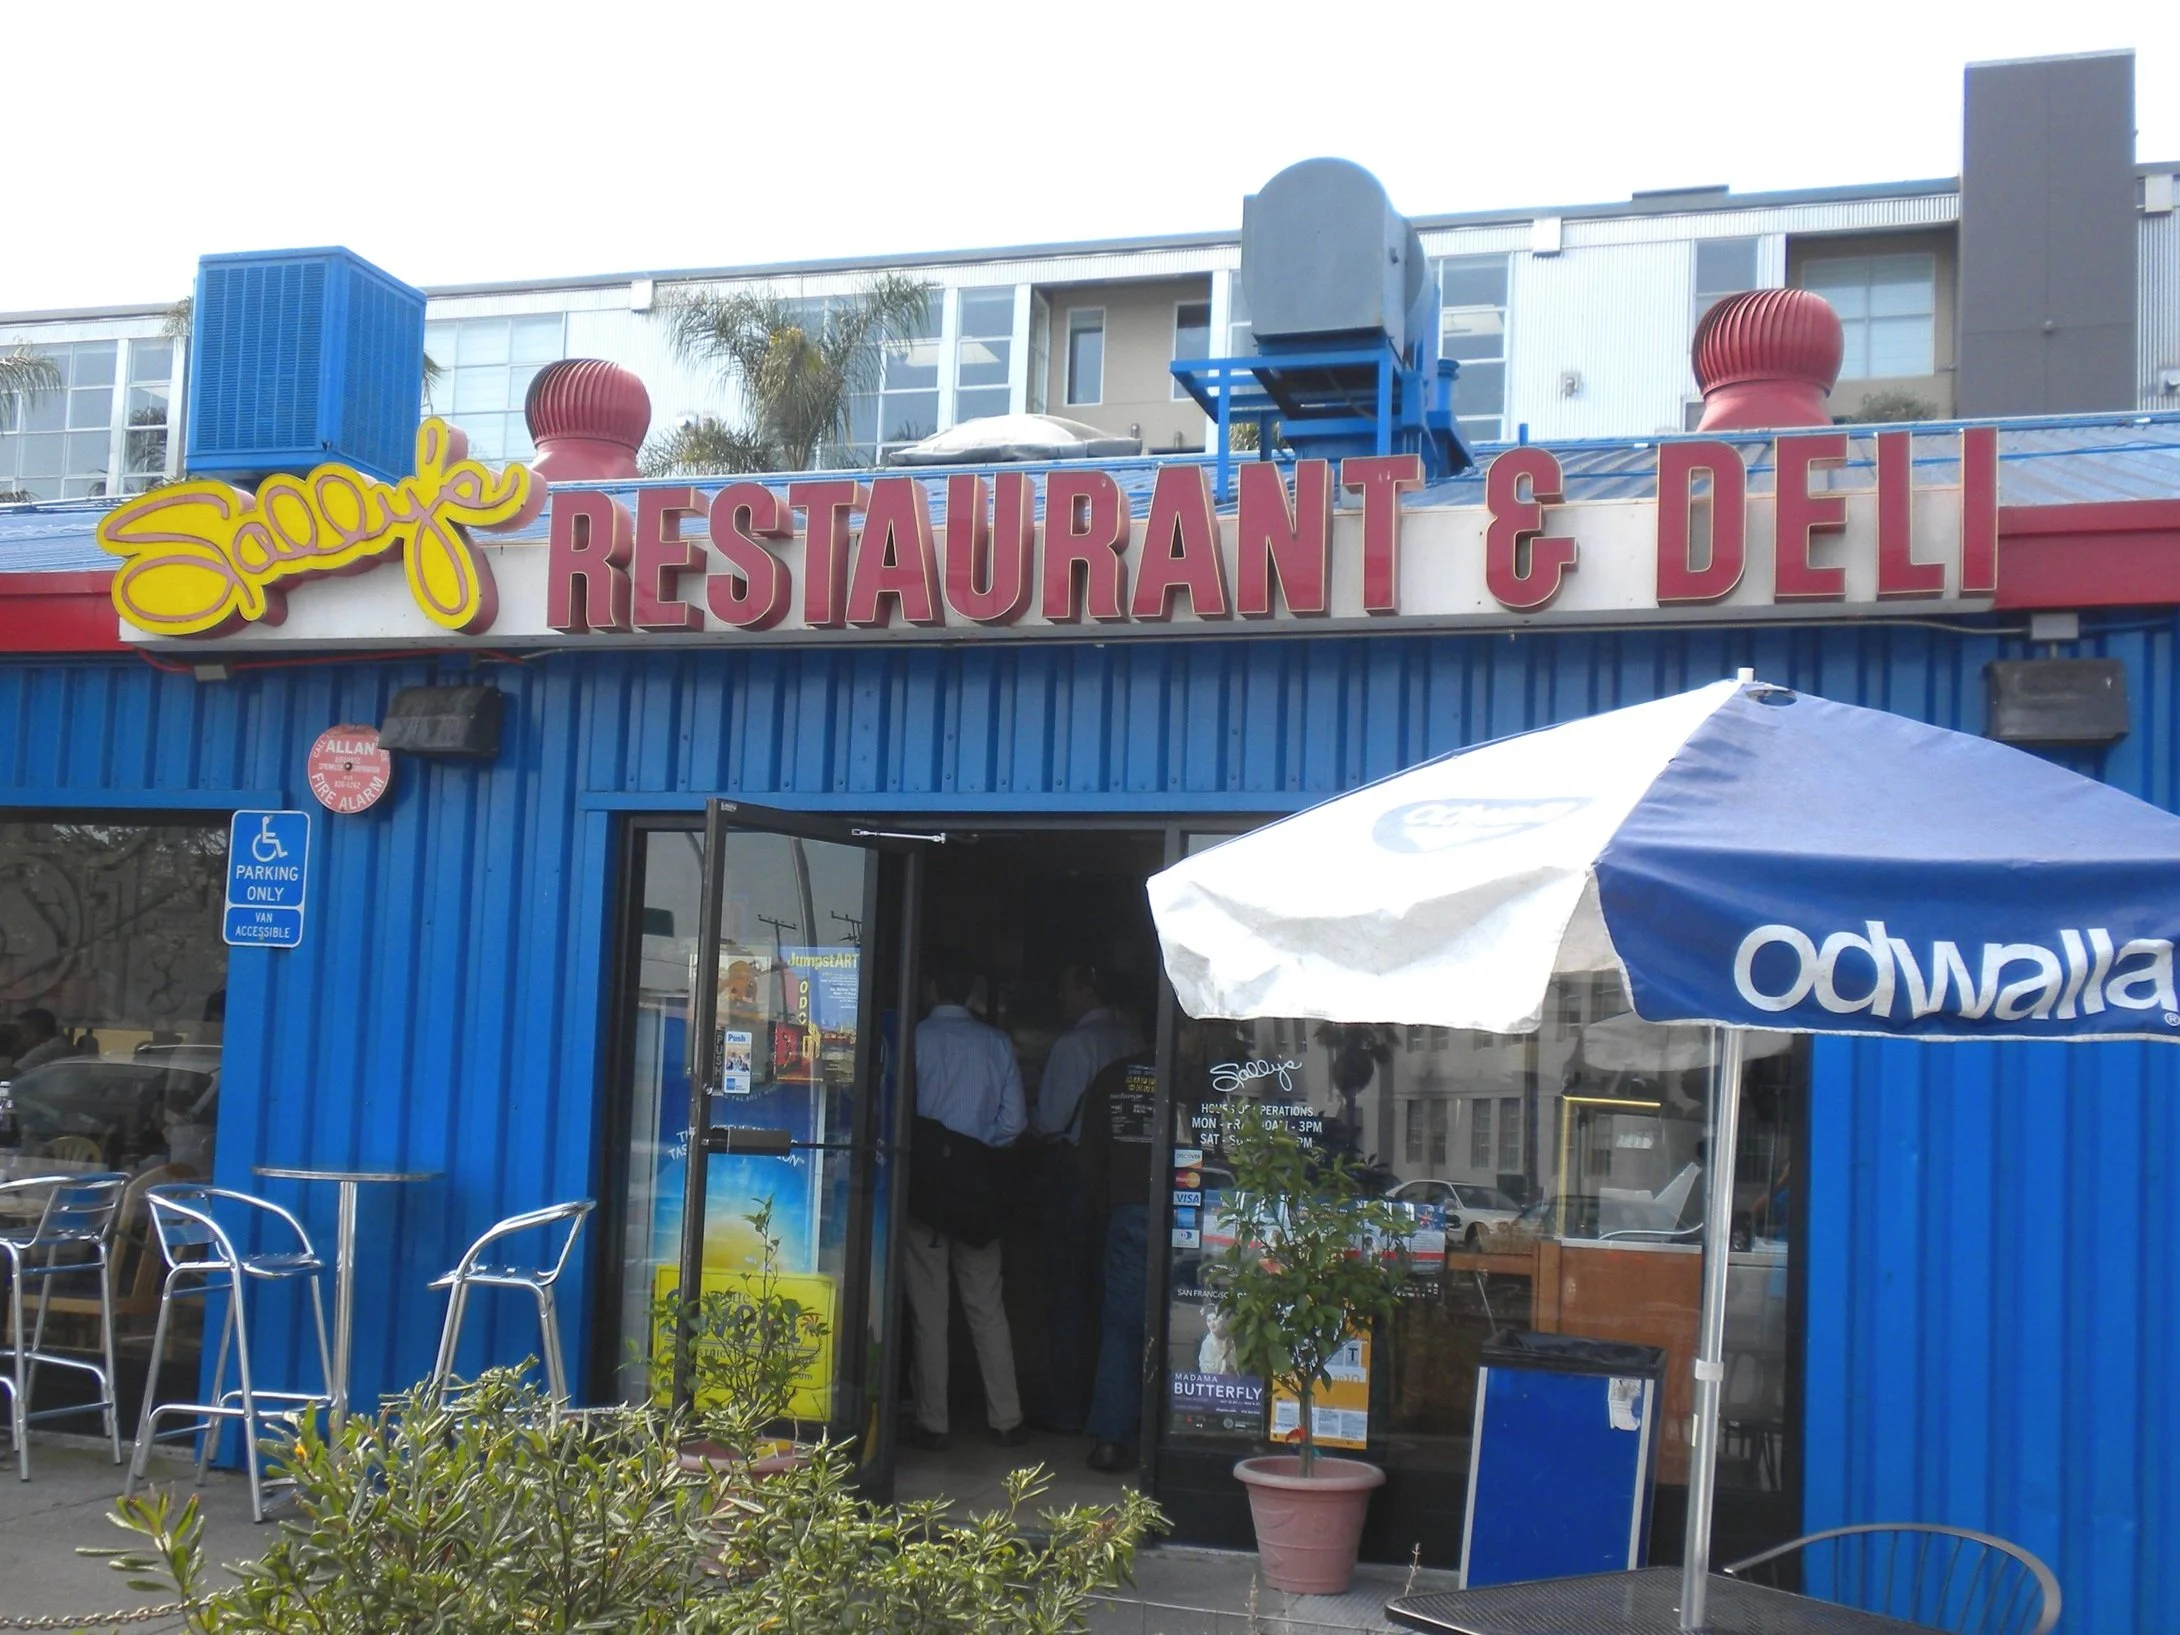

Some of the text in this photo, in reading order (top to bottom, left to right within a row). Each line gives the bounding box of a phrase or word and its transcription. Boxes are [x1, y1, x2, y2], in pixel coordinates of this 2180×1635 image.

[98, 418, 1998, 634] Sally's RESTAURANT & DELI
[325, 739, 375, 756] ALLAN
[312, 772, 385, 810] FIRE ALARM
[235, 865, 299, 881] PARKING
[246, 886, 285, 902] ONLY
[255, 912, 273, 923] VAN
[235, 925, 291, 939] ACCESSIBLE
[787, 952, 860, 970] JumpstART
[727, 1033, 747, 1043] Push
[713, 1035, 724, 1077] PUSH
[1209, 1055, 1303, 1092] Sally's
[1252, 1104, 1314, 1117] PERATIONS
[1191, 1117, 1217, 1129] MON
[1298, 1121, 1323, 1133] 3PM
[1200, 1132, 1220, 1145] SAT
[1176, 1193, 1201, 1204] VISA
[1177, 1288, 1193, 1297] SAN
[1174, 1373, 1219, 1384] MADAMA
[1173, 1383, 1263, 1401] BUTTERFLY
